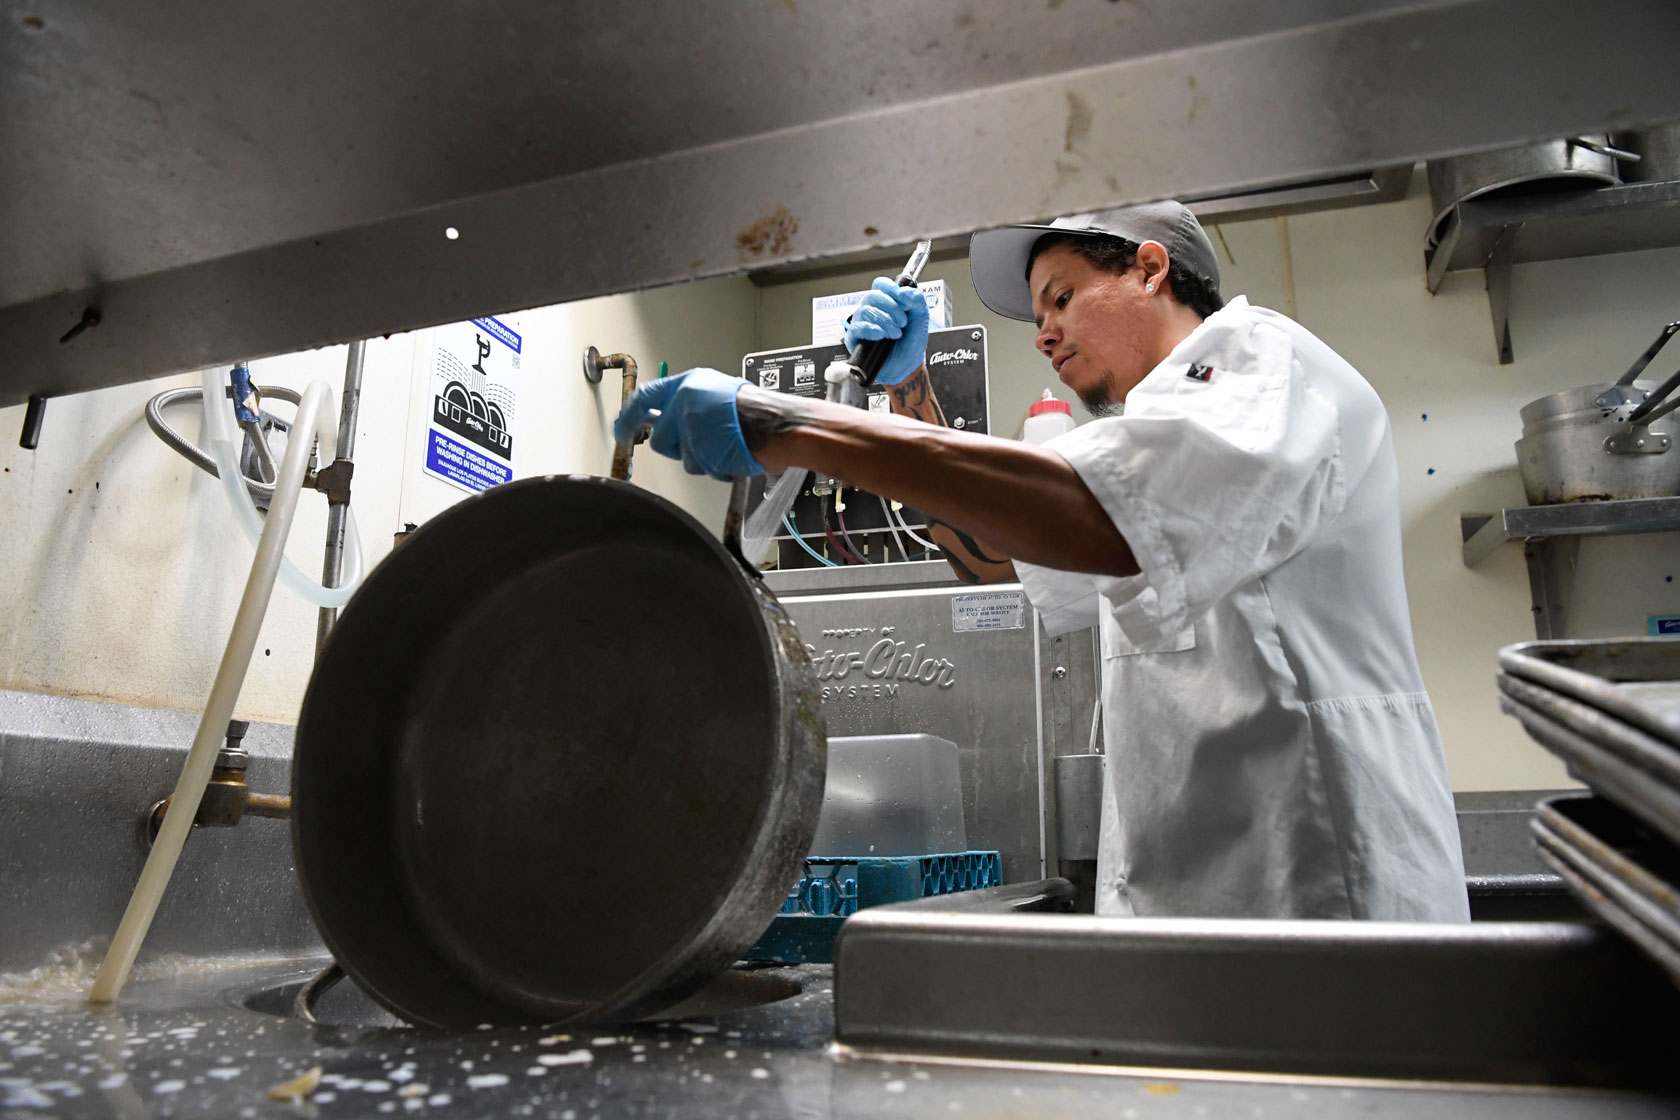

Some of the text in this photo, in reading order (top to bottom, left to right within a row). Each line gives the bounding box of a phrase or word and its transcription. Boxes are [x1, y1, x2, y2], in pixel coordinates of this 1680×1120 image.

[922, 286, 942, 294] XAM
[929, 348, 979, 366] Auto-Chlor
[435, 435, 508, 478] PRE-RINSE DISHES BEFORE
[436, 445, 505, 485] WASHING IN DISHWASHER
[822, 626, 896, 639] PROPERTY OF
[821, 683, 900, 700] SYSTEM
